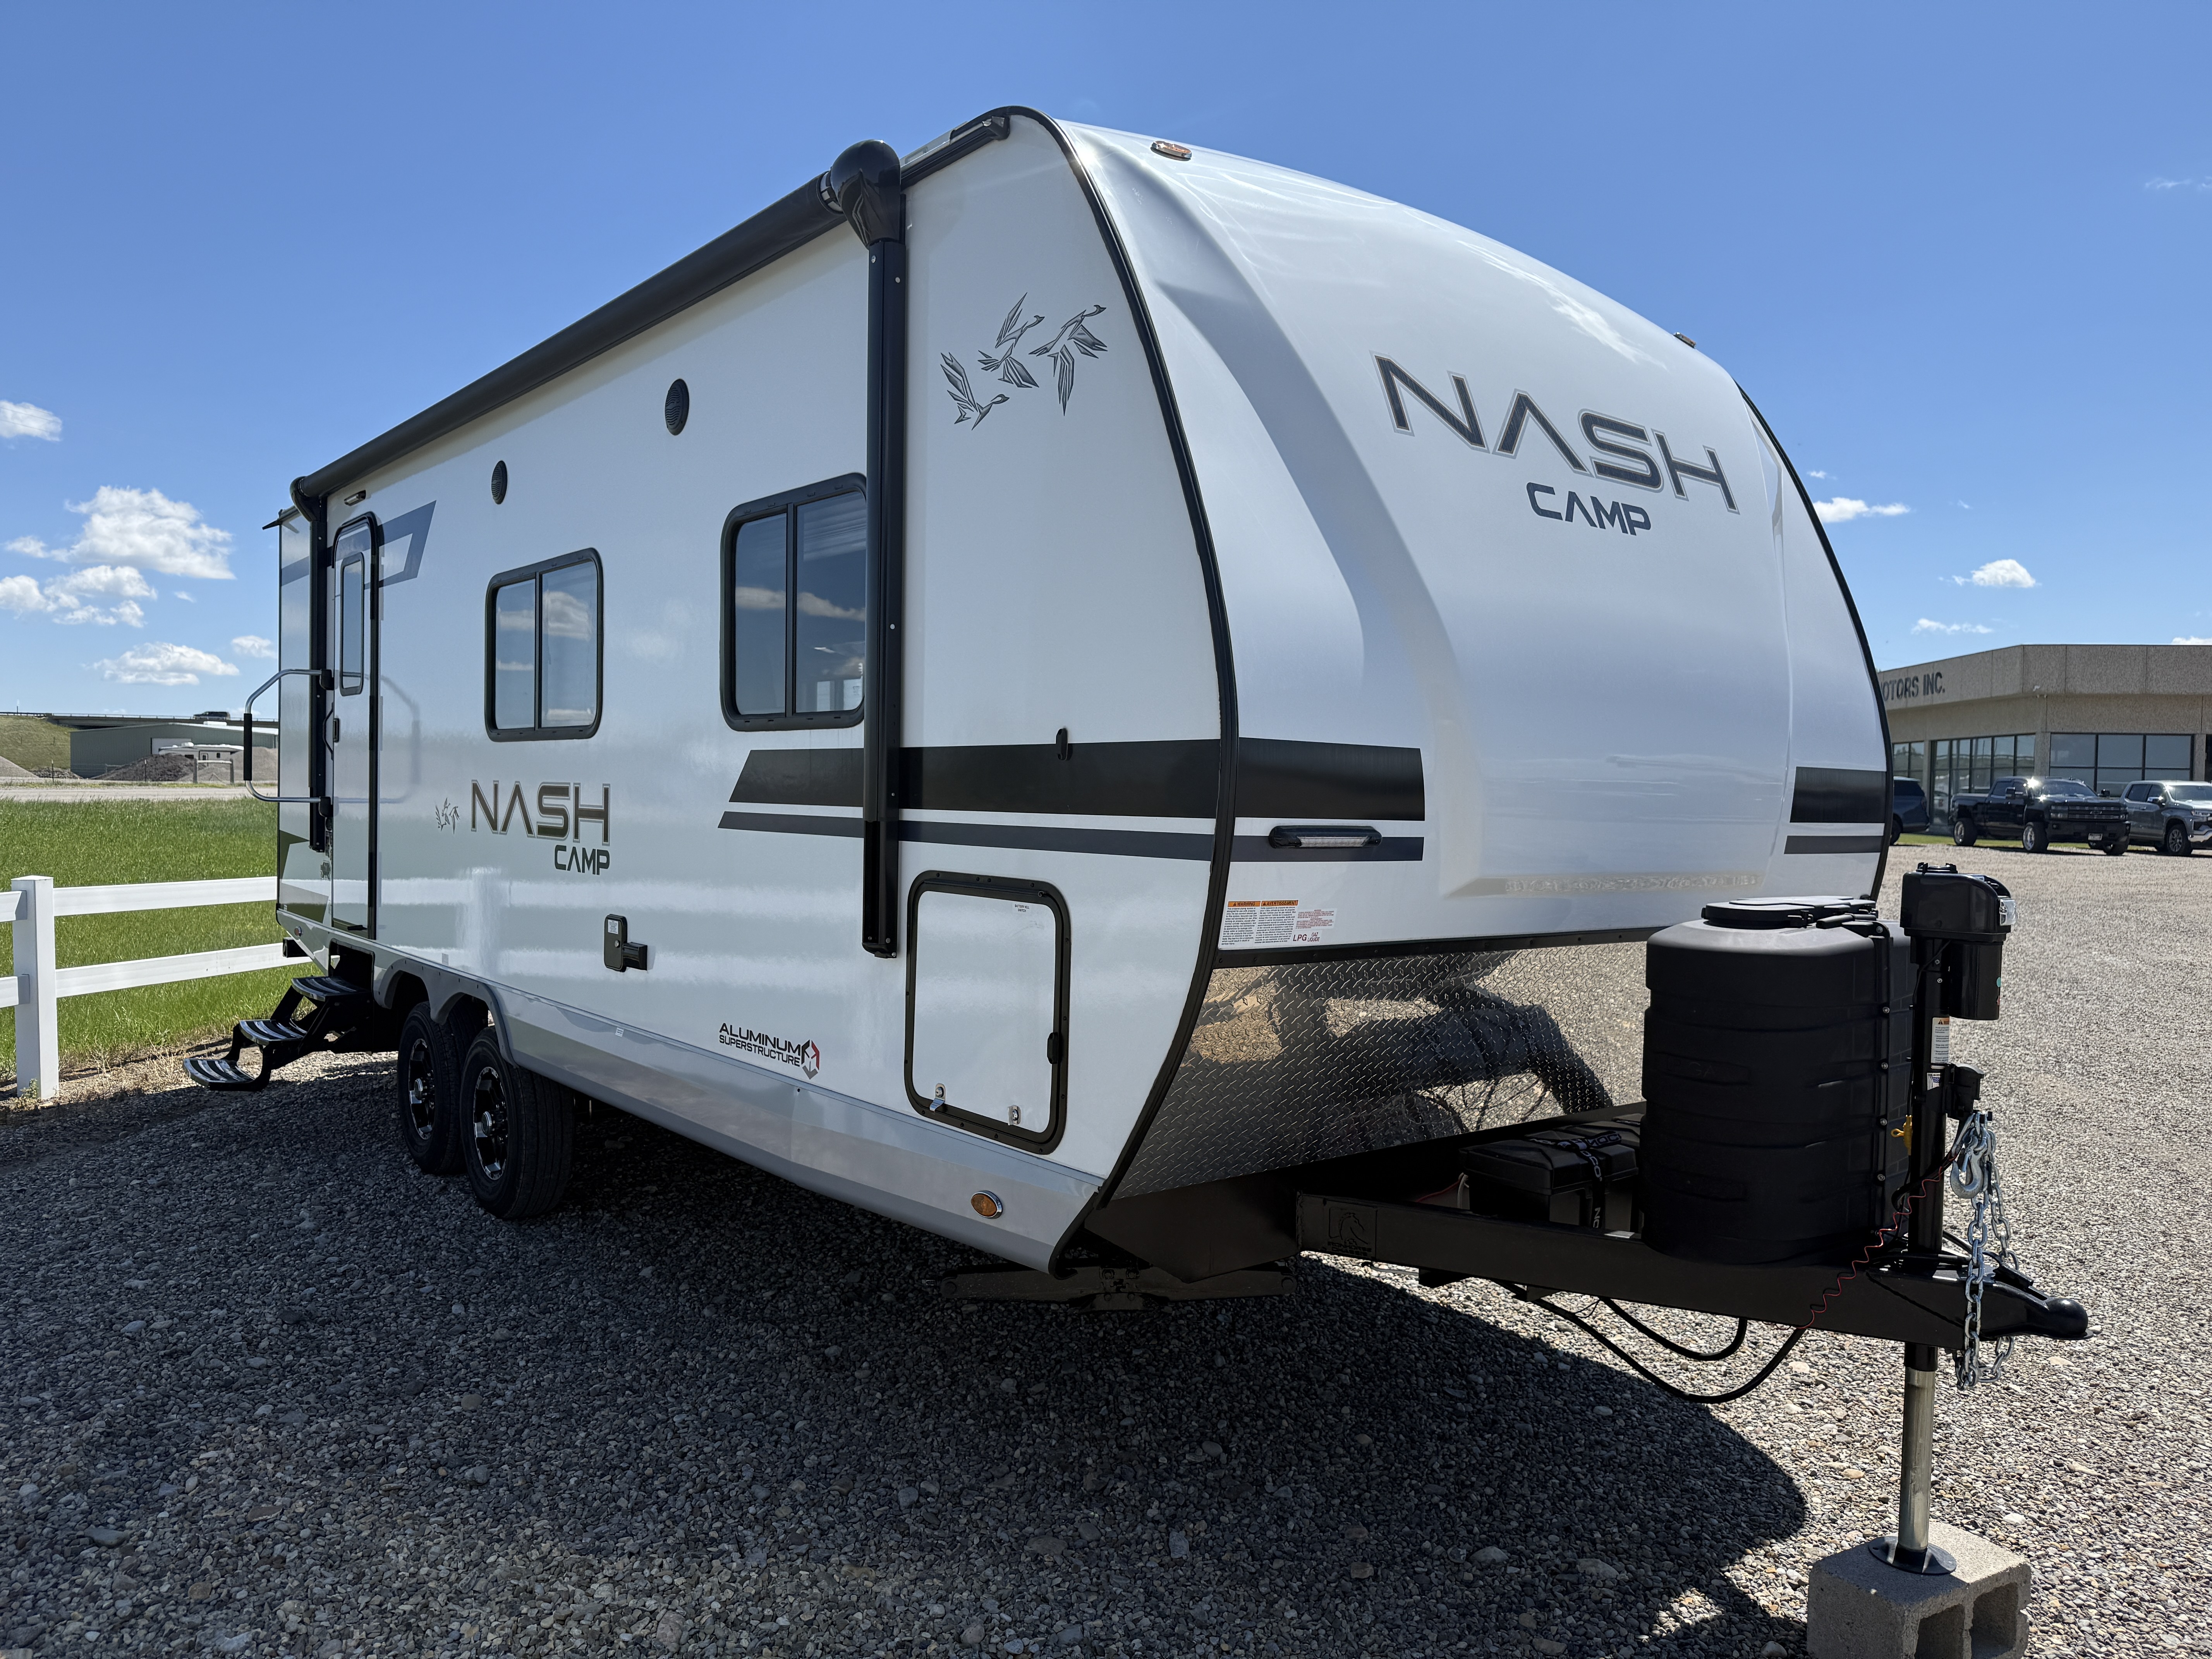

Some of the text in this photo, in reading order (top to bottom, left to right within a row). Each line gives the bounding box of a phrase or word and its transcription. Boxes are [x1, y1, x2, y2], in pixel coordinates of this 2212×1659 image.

[1370, 351, 1740, 514] NASH
[1526, 482, 1651, 536] CAMP
[1881, 672, 1945, 701] OTORS INC.
[471, 780, 610, 846] NASH
[555, 845, 610, 875] CAMP
[719, 1023, 800, 1056] ALUMINUM
[719, 1034, 800, 1067] SUPERSTRUCTURE
